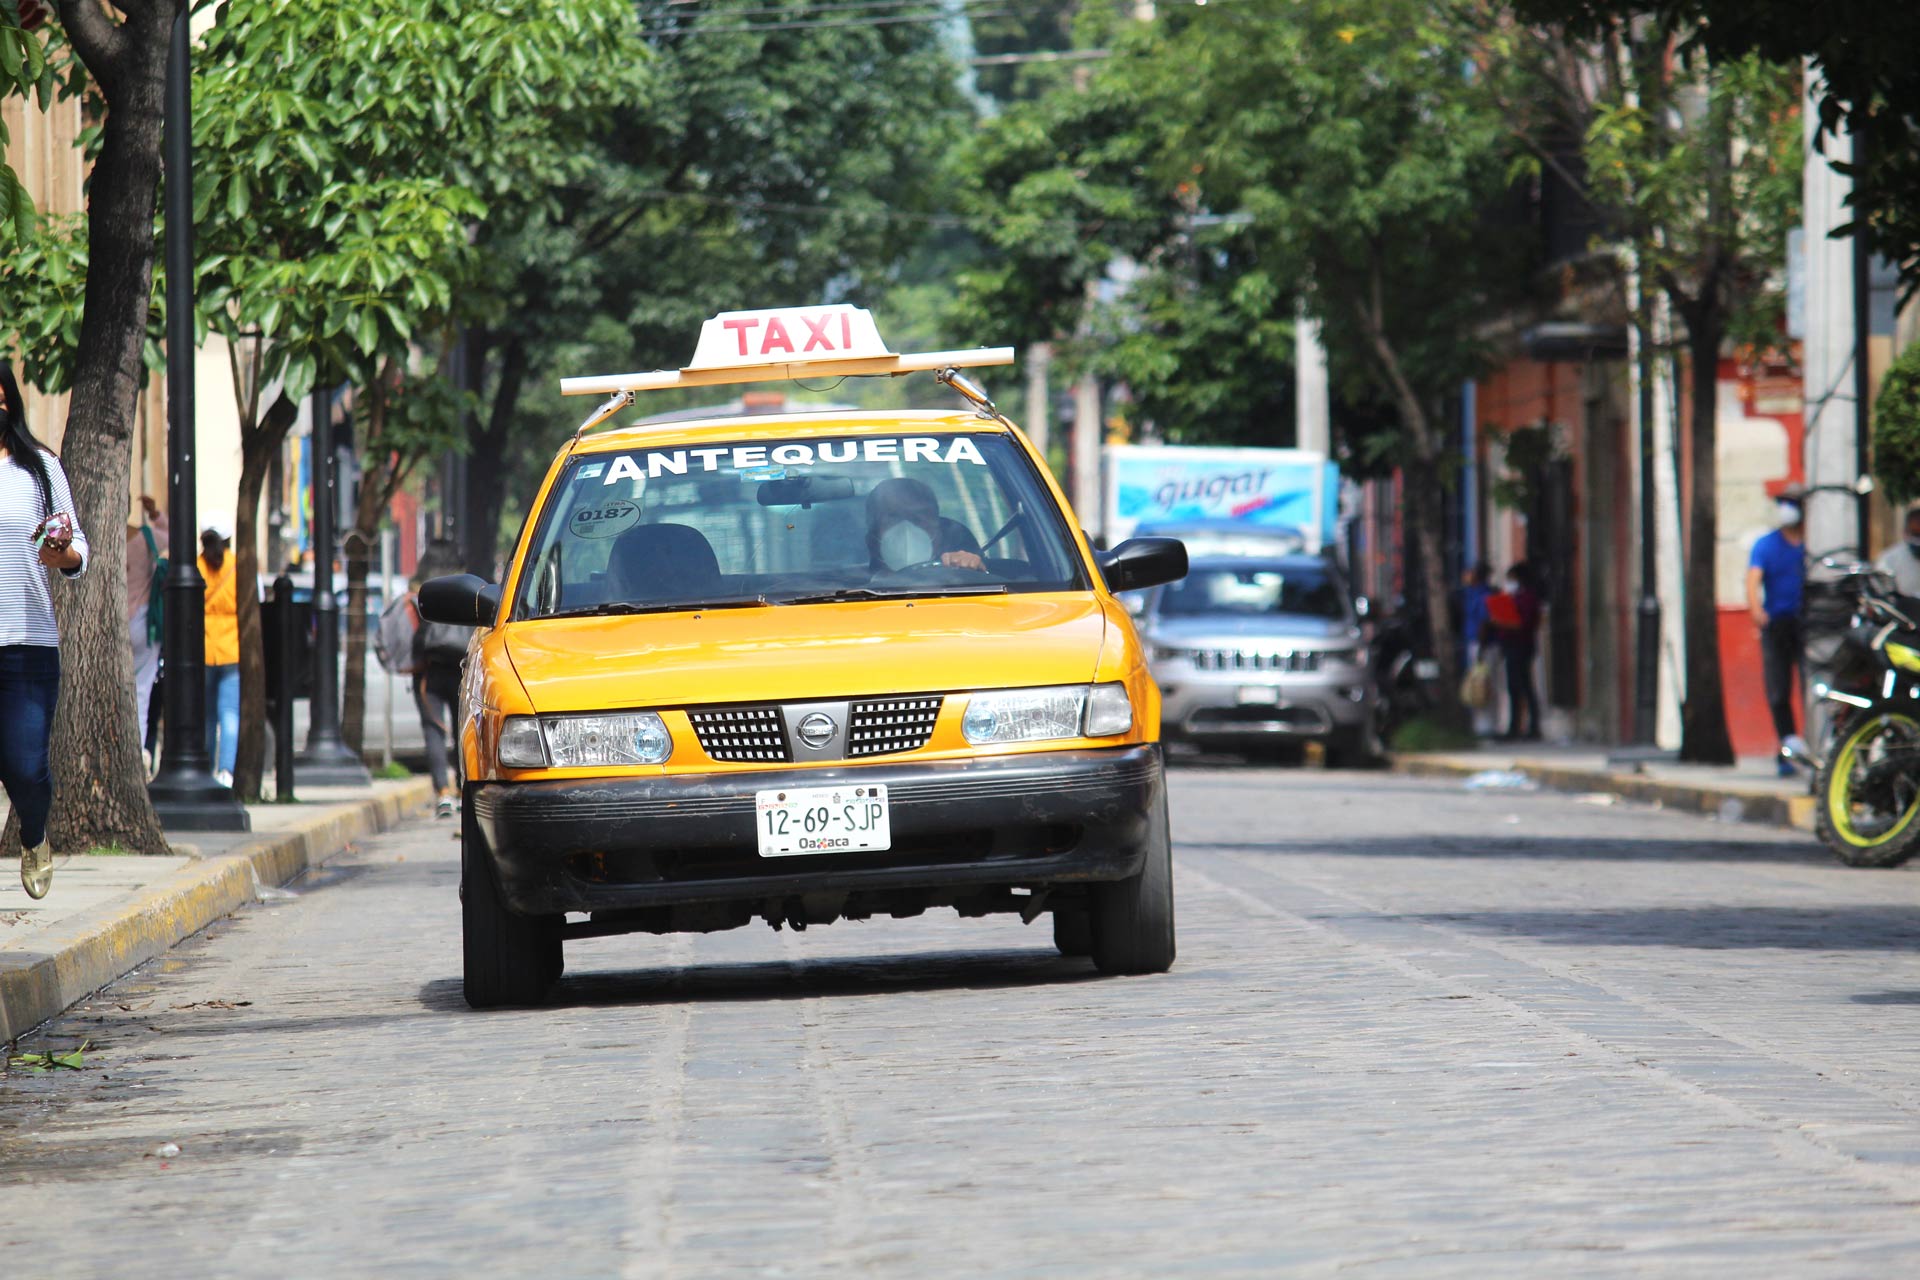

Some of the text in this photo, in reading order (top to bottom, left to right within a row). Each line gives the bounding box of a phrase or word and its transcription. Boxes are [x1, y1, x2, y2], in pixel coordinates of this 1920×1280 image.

[723, 313, 852, 356] TAXI
[602, 437, 987, 486] ANTEQUERA
[1154, 467, 1274, 514] gugar
[577, 507, 635, 522] 0187
[766, 803, 883, 836] 12-69-SJP
[798, 837, 850, 850] Oaxaca
